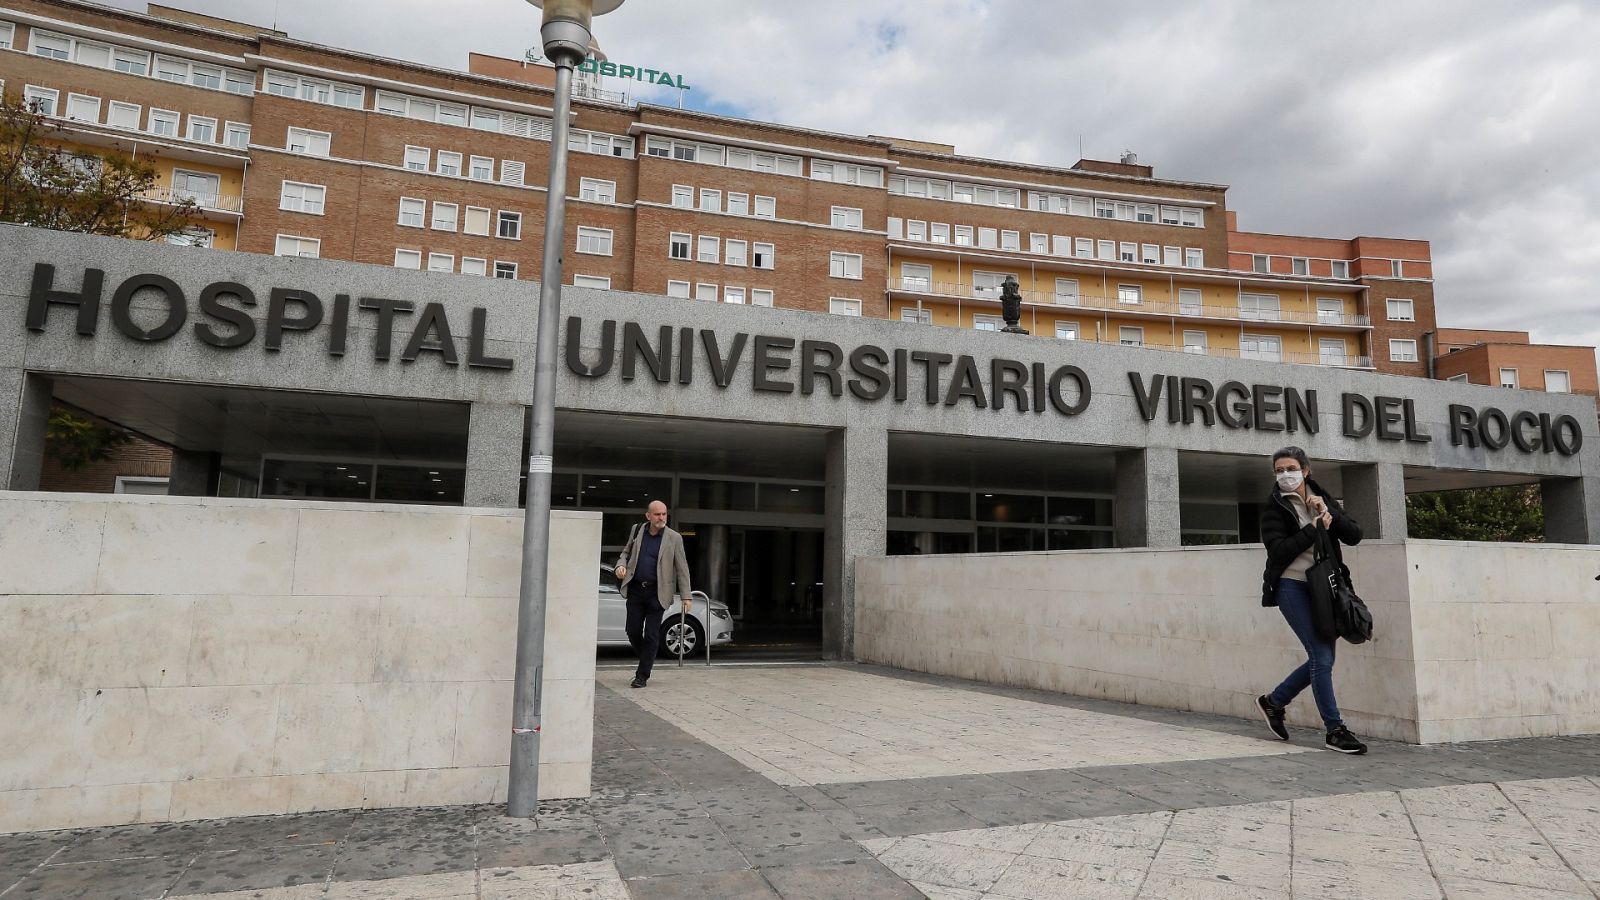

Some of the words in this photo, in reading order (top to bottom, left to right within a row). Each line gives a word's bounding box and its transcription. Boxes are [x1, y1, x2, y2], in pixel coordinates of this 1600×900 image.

[577, 58, 690, 90] OSPITAL
[26, 262, 513, 369] HOSPITAL
[566, 316, 1092, 415] UNIVERSITARIO
[1128, 371, 1319, 434] VIRGEN
[1342, 392, 1432, 443] DEL
[1449, 403, 1583, 456] ROCIO
